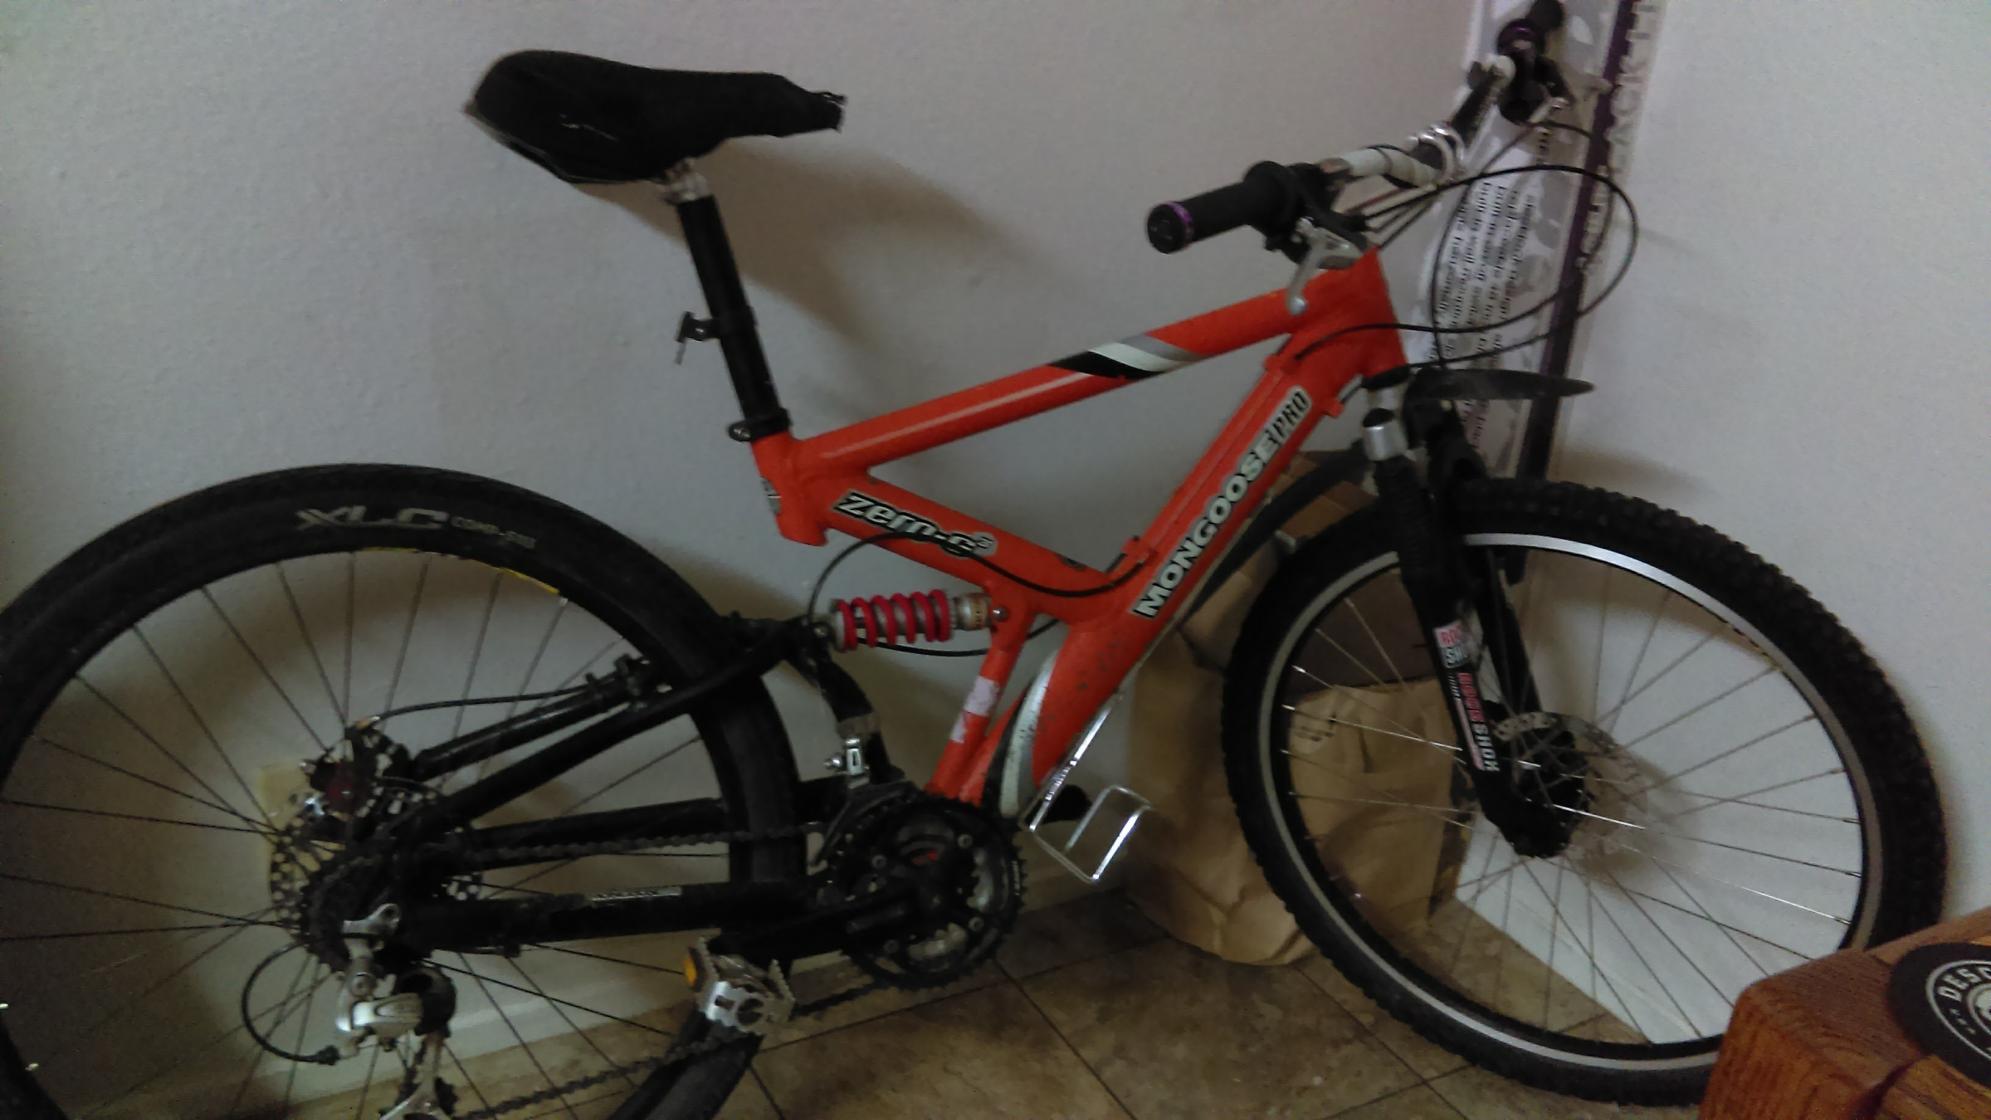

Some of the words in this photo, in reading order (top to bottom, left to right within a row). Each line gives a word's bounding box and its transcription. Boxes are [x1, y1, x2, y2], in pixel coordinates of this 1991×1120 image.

[297, 505, 449, 531] XLC
[1132, 428, 1284, 618] MONGOOSE
[1273, 388, 1310, 440] PRO
